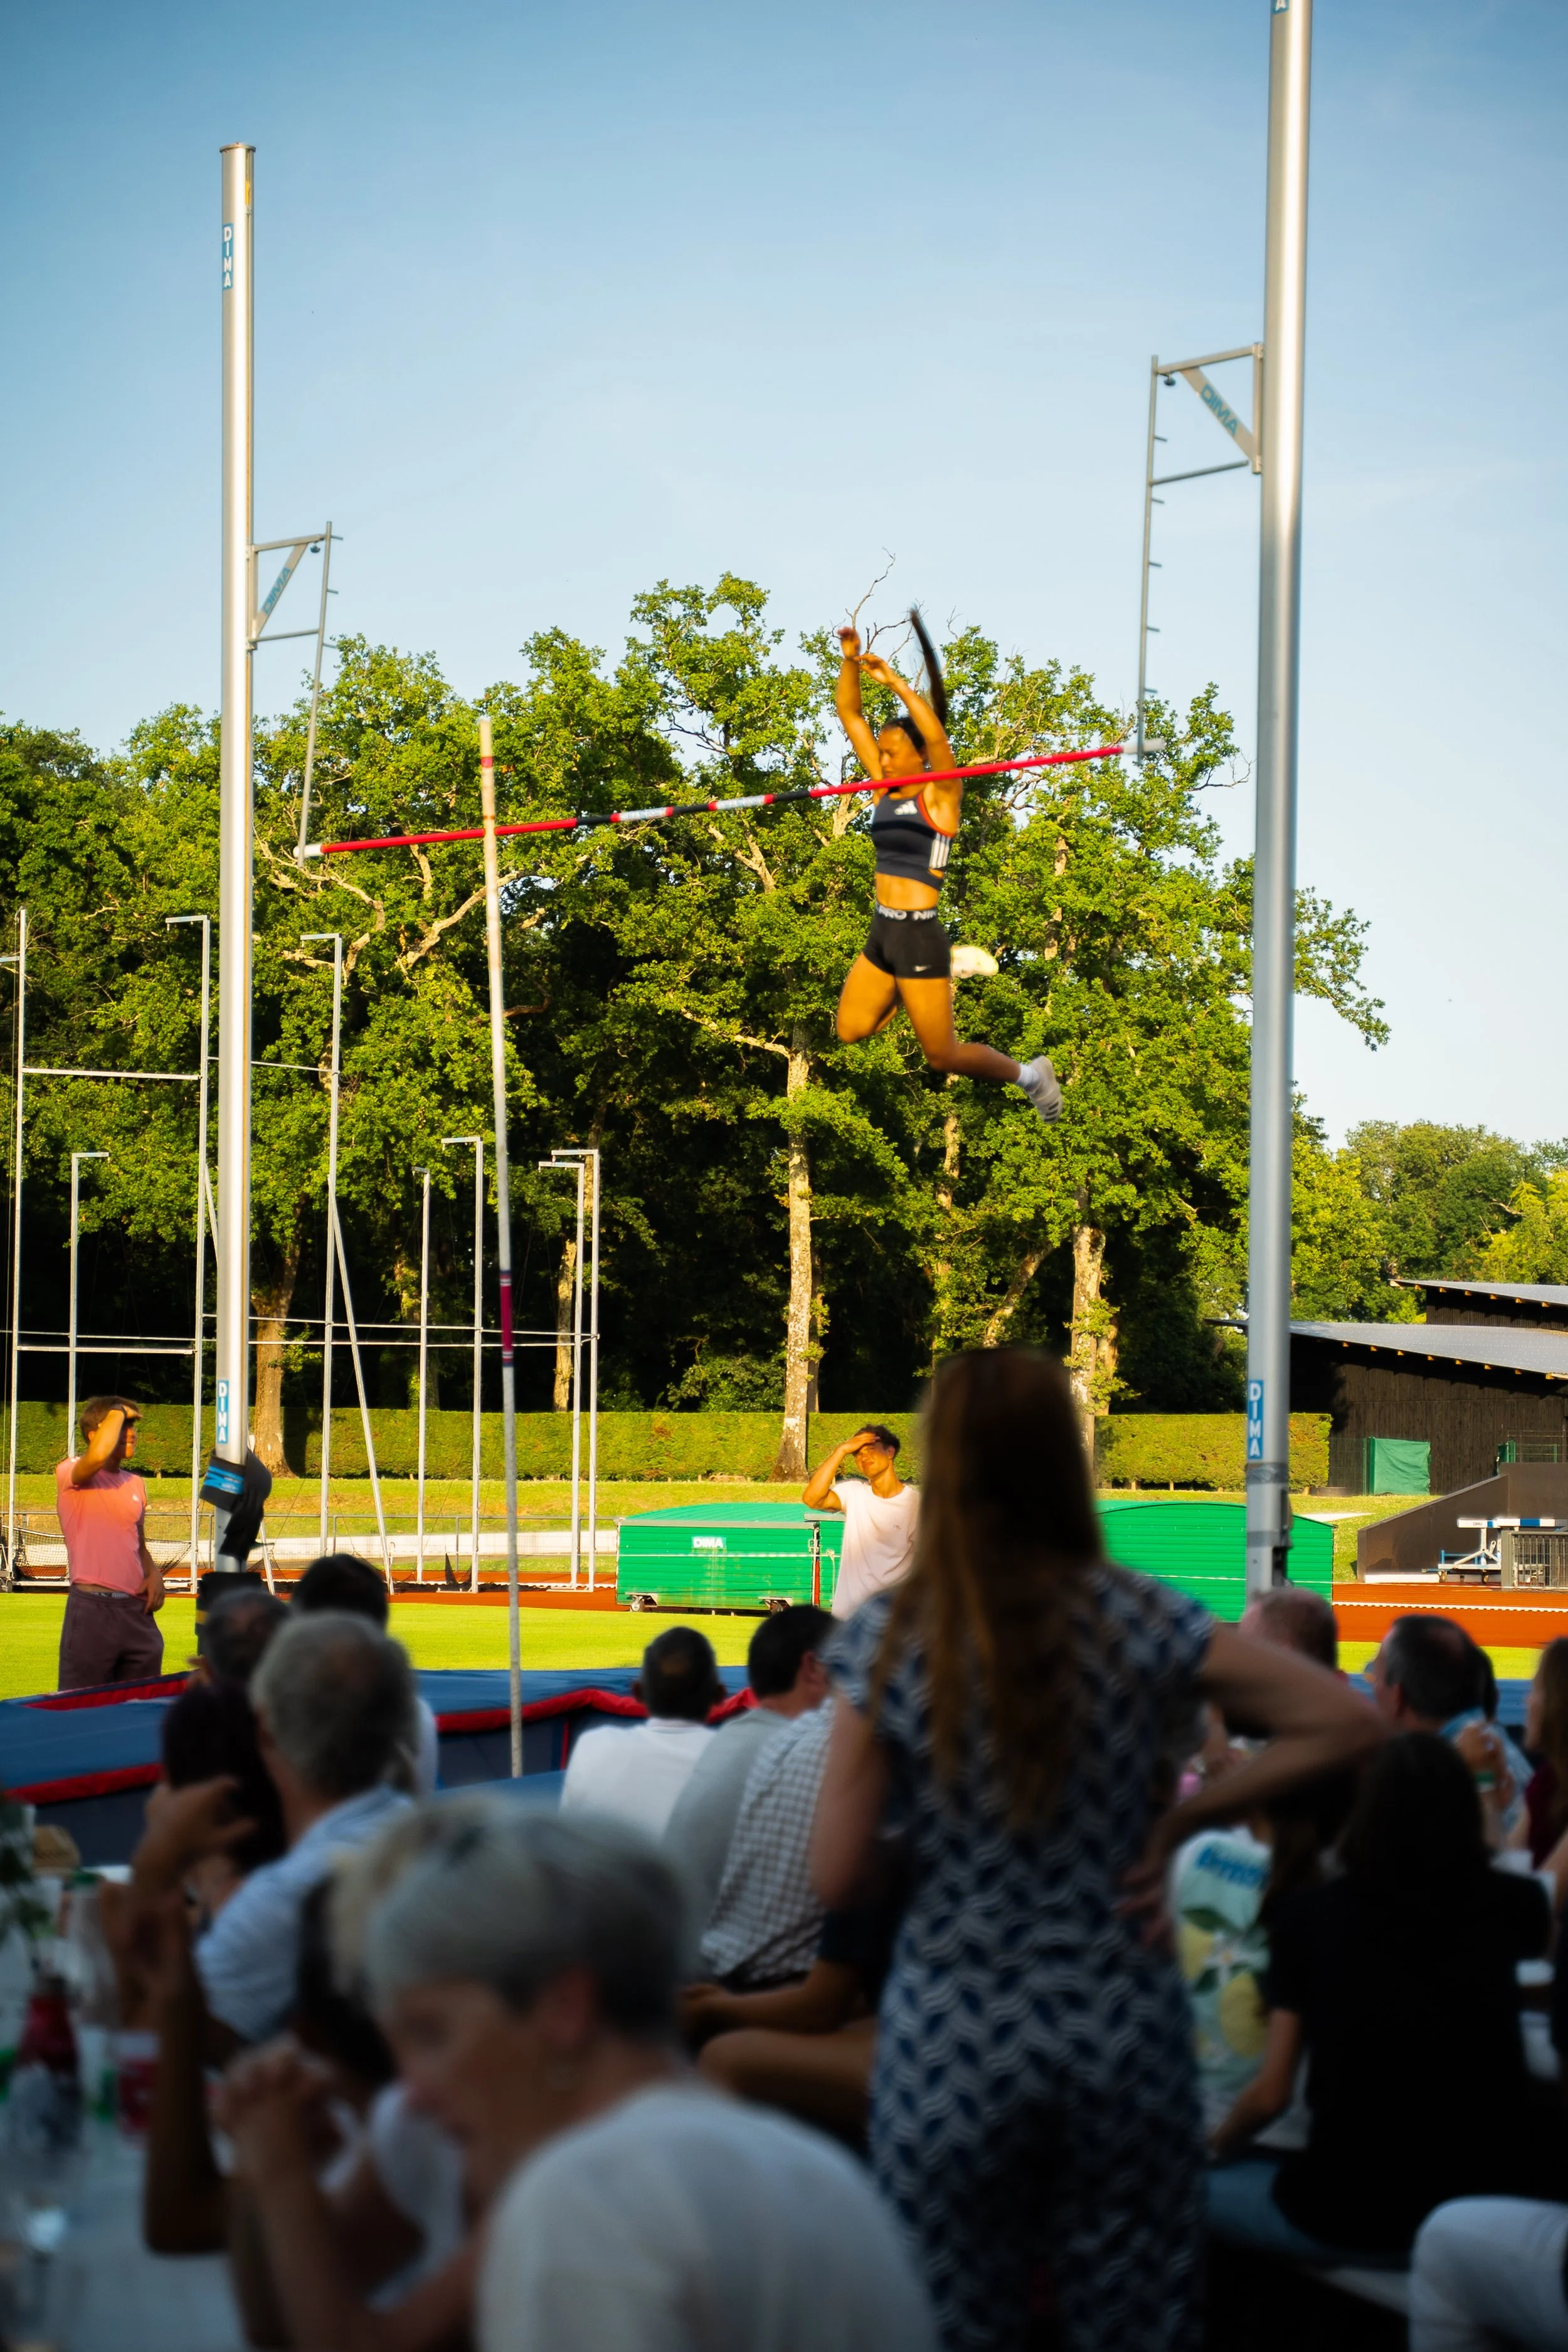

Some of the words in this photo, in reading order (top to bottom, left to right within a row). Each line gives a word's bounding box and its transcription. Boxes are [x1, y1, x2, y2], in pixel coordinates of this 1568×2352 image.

[223, 226, 231, 287] DIMA
[1201, 384, 1237, 435] DIMA
[262, 567, 290, 614] DIMA
[218, 1382, 227, 1442] DIMA
[1249, 1383, 1262, 1456] DIMA
[693, 1537, 724, 1548] DIMA
